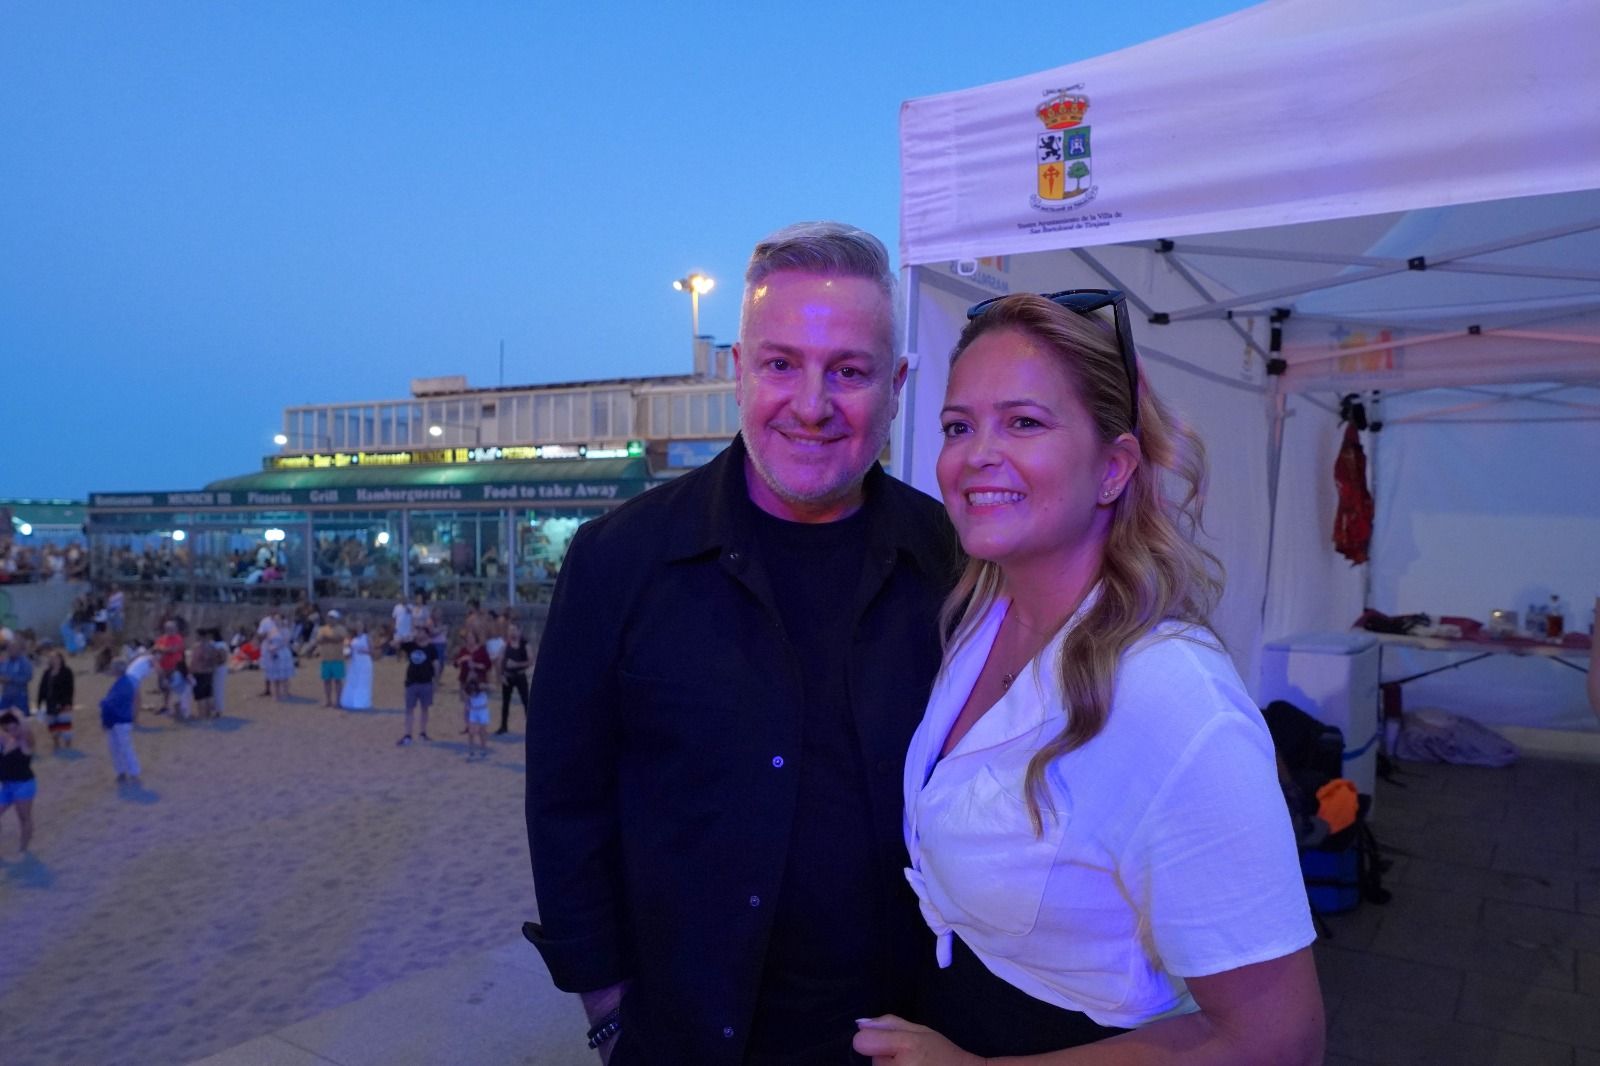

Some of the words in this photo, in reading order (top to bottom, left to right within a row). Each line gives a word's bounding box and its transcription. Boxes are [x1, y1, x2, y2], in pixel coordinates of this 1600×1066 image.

[1097, 211, 1113, 219] Villa
[309, 488, 339, 504] Grill
[483, 484, 517, 499] Food
[520, 486, 536, 498] to
[538, 484, 573, 498] take
[575, 483, 618, 498] Away
